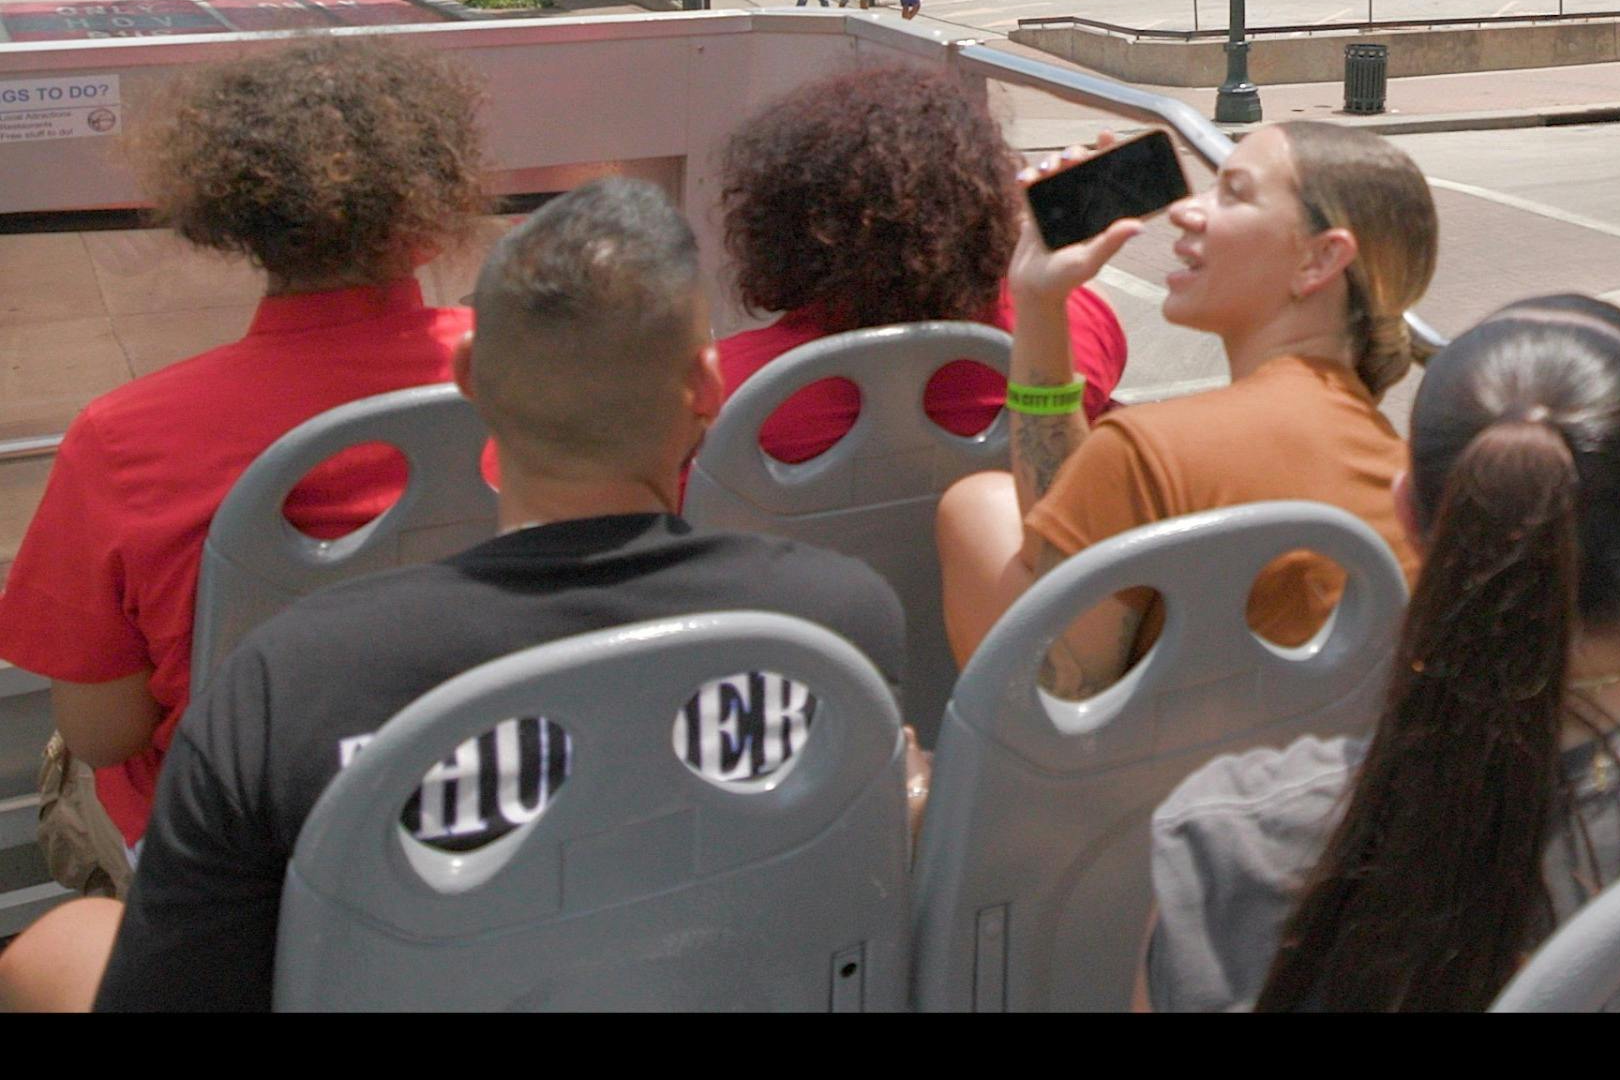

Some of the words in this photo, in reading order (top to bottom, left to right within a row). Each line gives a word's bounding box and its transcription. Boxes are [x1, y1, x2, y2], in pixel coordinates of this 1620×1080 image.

[0, 88, 30, 103] GS
[35, 86, 63, 101] TO
[69, 84, 109, 99] DO?
